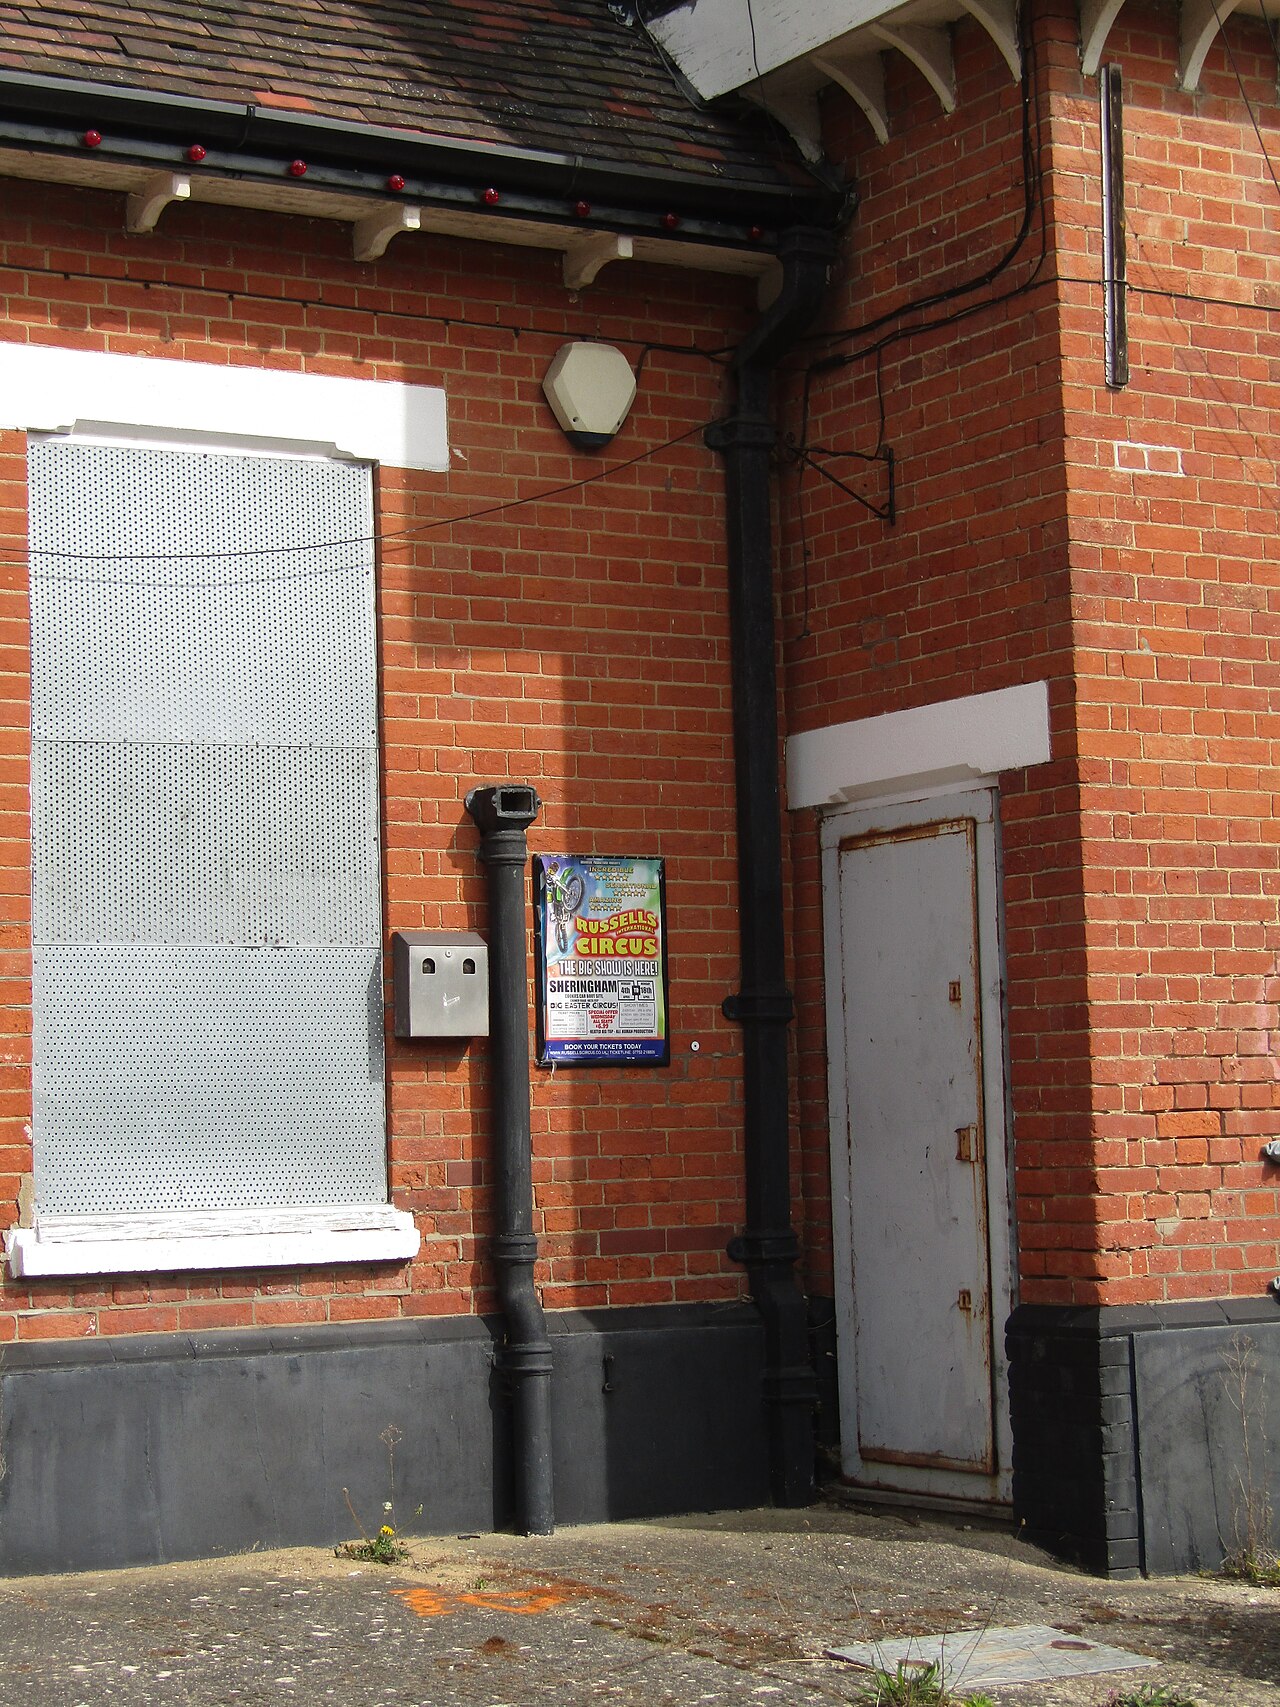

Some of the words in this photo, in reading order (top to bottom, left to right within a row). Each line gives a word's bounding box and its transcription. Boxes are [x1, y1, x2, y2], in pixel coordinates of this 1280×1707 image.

[589, 866, 634, 874] INCREDIBLE
[576, 911, 657, 934] RUSSELLS
[616, 924, 654, 935] INTERNATIONAL
[576, 938, 657, 955] CIRCUS
[559, 960, 576, 976] THE
[578, 960, 593, 976] BIG
[595, 960, 621, 976] SHOW
[622, 961, 632, 976] IS
[634, 961, 658, 976] HERE!
[549, 980, 617, 993] SHERINGHAM
[621, 986, 631, 994] 4th
